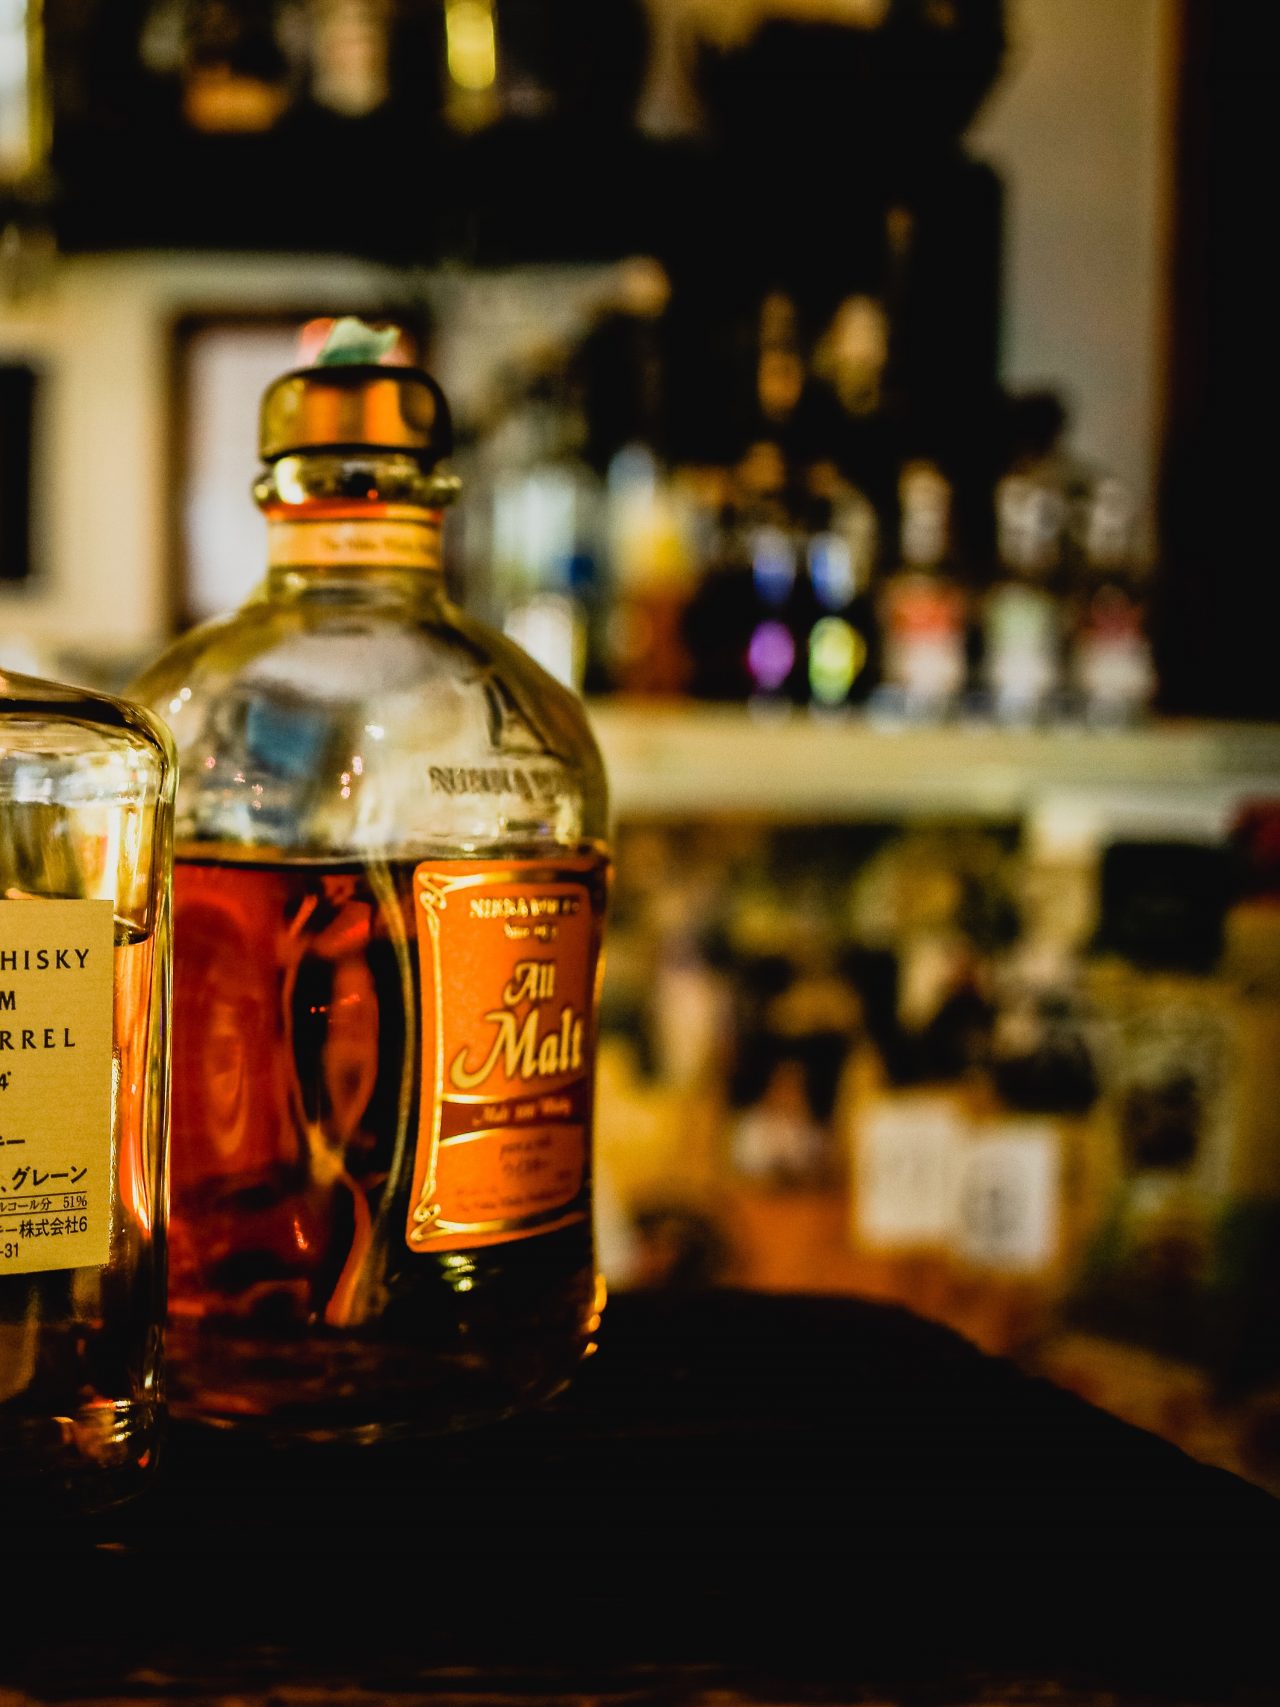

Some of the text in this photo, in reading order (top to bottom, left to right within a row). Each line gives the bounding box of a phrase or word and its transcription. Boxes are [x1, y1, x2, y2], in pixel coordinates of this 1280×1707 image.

[503, 961, 556, 1007] All
[450, 1008, 584, 1090] Malt
[63, 1195, 88, 1209] 51%
